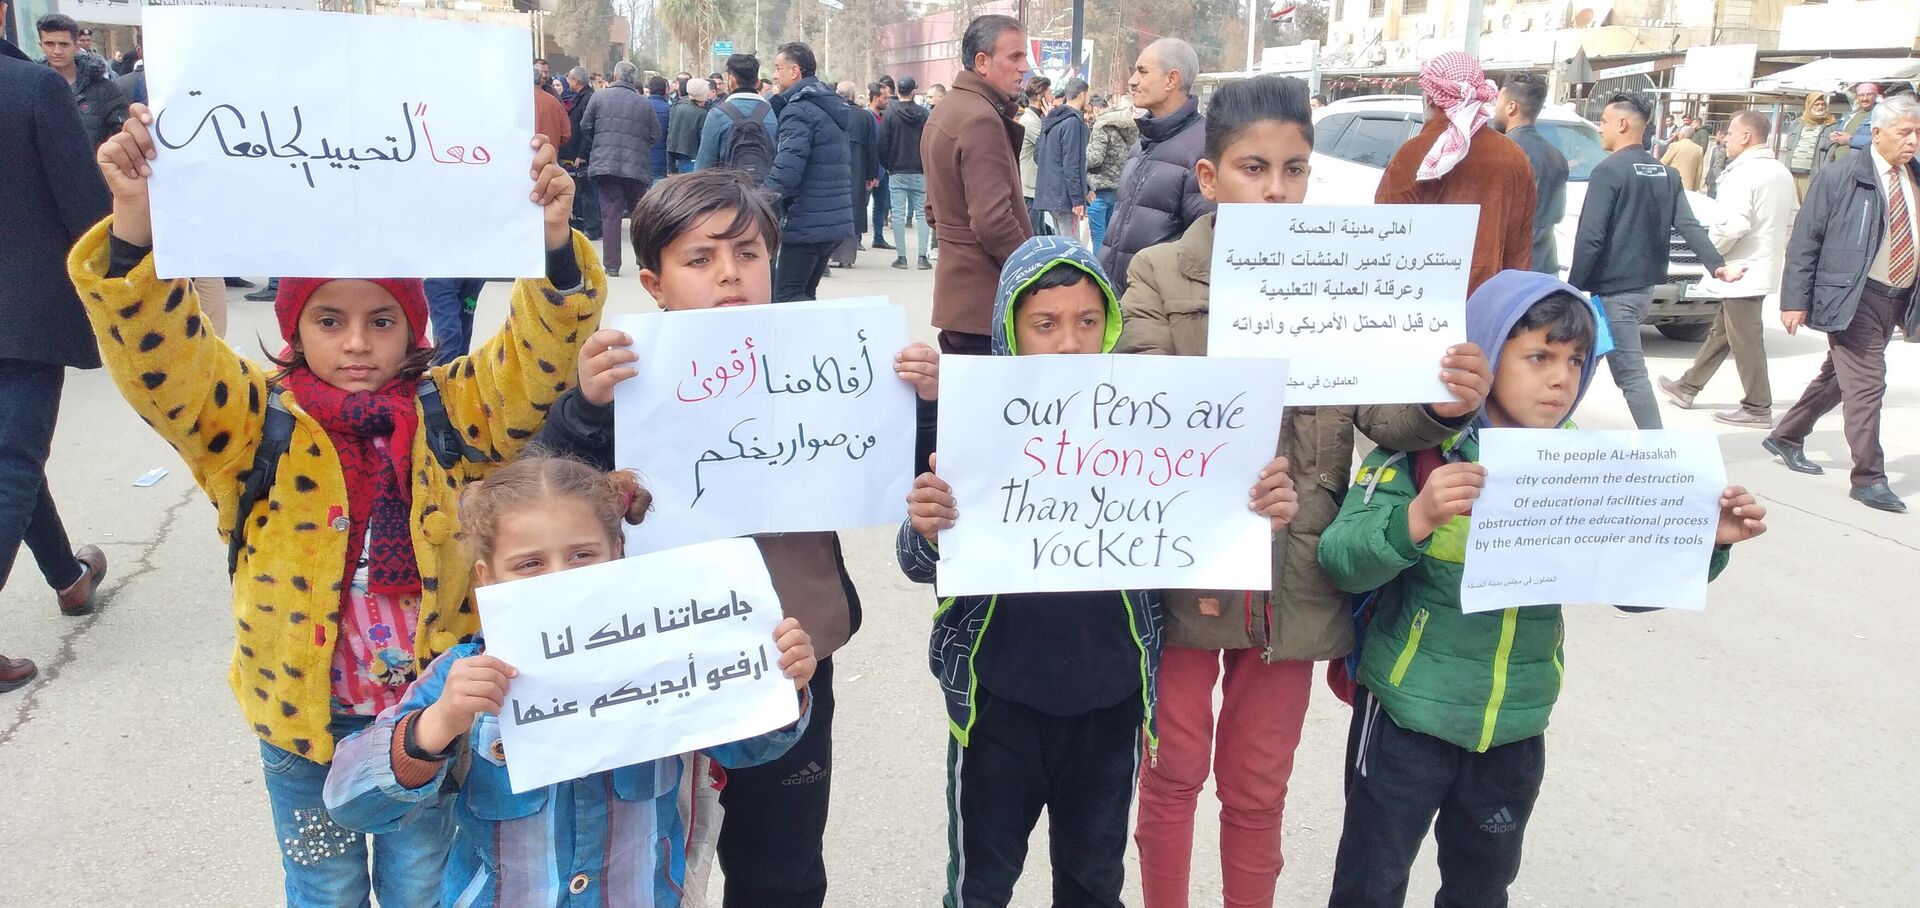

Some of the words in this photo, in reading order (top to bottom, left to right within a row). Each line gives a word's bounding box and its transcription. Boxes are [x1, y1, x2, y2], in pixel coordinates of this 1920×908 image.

[1289, 219, 1336, 235] الحسكة
[1341, 219, 1374, 238] مدينة
[1378, 219, 1413, 241] أهالي
[1226, 249, 1285, 270] التعليمية
[1291, 249, 1348, 267] المنشآت
[1354, 252, 1391, 271] تدمير
[1396, 252, 1462, 271] يستنكرون
[1260, 279, 1317, 301] التعليمية
[1322, 279, 1368, 300] العملية
[1374, 279, 1424, 300] وعرقلة
[1232, 312, 1284, 335] وأدواته
[1289, 312, 1347, 337] الأمريكي
[1353, 314, 1396, 332] المحتل
[1402, 312, 1423, 332] قبل
[1429, 316, 1448, 332] من
[1286, 377, 1304, 389] مجل
[1308, 376, 1320, 390] في
[1323, 376, 1358, 388] العاملون
[1186, 391, 1247, 429] are
[846, 434, 876, 460] من
[1537, 449, 1559, 461] The
[1564, 448, 1607, 463] people
[1610, 447, 1677, 461] AL-Hasakah
[690, 417, 848, 508] صواريخكم
[1515, 474, 1539, 487] city
[1541, 474, 1599, 485] condemn
[1602, 473, 1622, 484] the
[1625, 472, 1695, 485] destruction
[1514, 497, 1529, 508] Of
[1532, 497, 1603, 508] educational
[1606, 496, 1657, 506] facilities
[1660, 496, 1684, 506] and
[1478, 517, 1546, 530] obstruction
[1550, 515, 1565, 526] of
[1566, 515, 1585, 525] the
[1588, 515, 1661, 526] educational
[1663, 516, 1710, 528] process
[1475, 539, 1489, 552] by
[1492, 537, 1511, 549] the
[1514, 534, 1571, 548] American
[1574, 533, 1625, 547] occupier
[1628, 534, 1652, 545] and
[1655, 534, 1670, 545] its
[1673, 534, 1703, 546] tools
[653, 590, 753, 634] جامعاتنا
[584, 613, 646, 650] ملك
[541, 625, 575, 660] لنا
[706, 644, 769, 691] ارفعو
[590, 652, 698, 717] أيديكم
[512, 698, 579, 726] عنها
